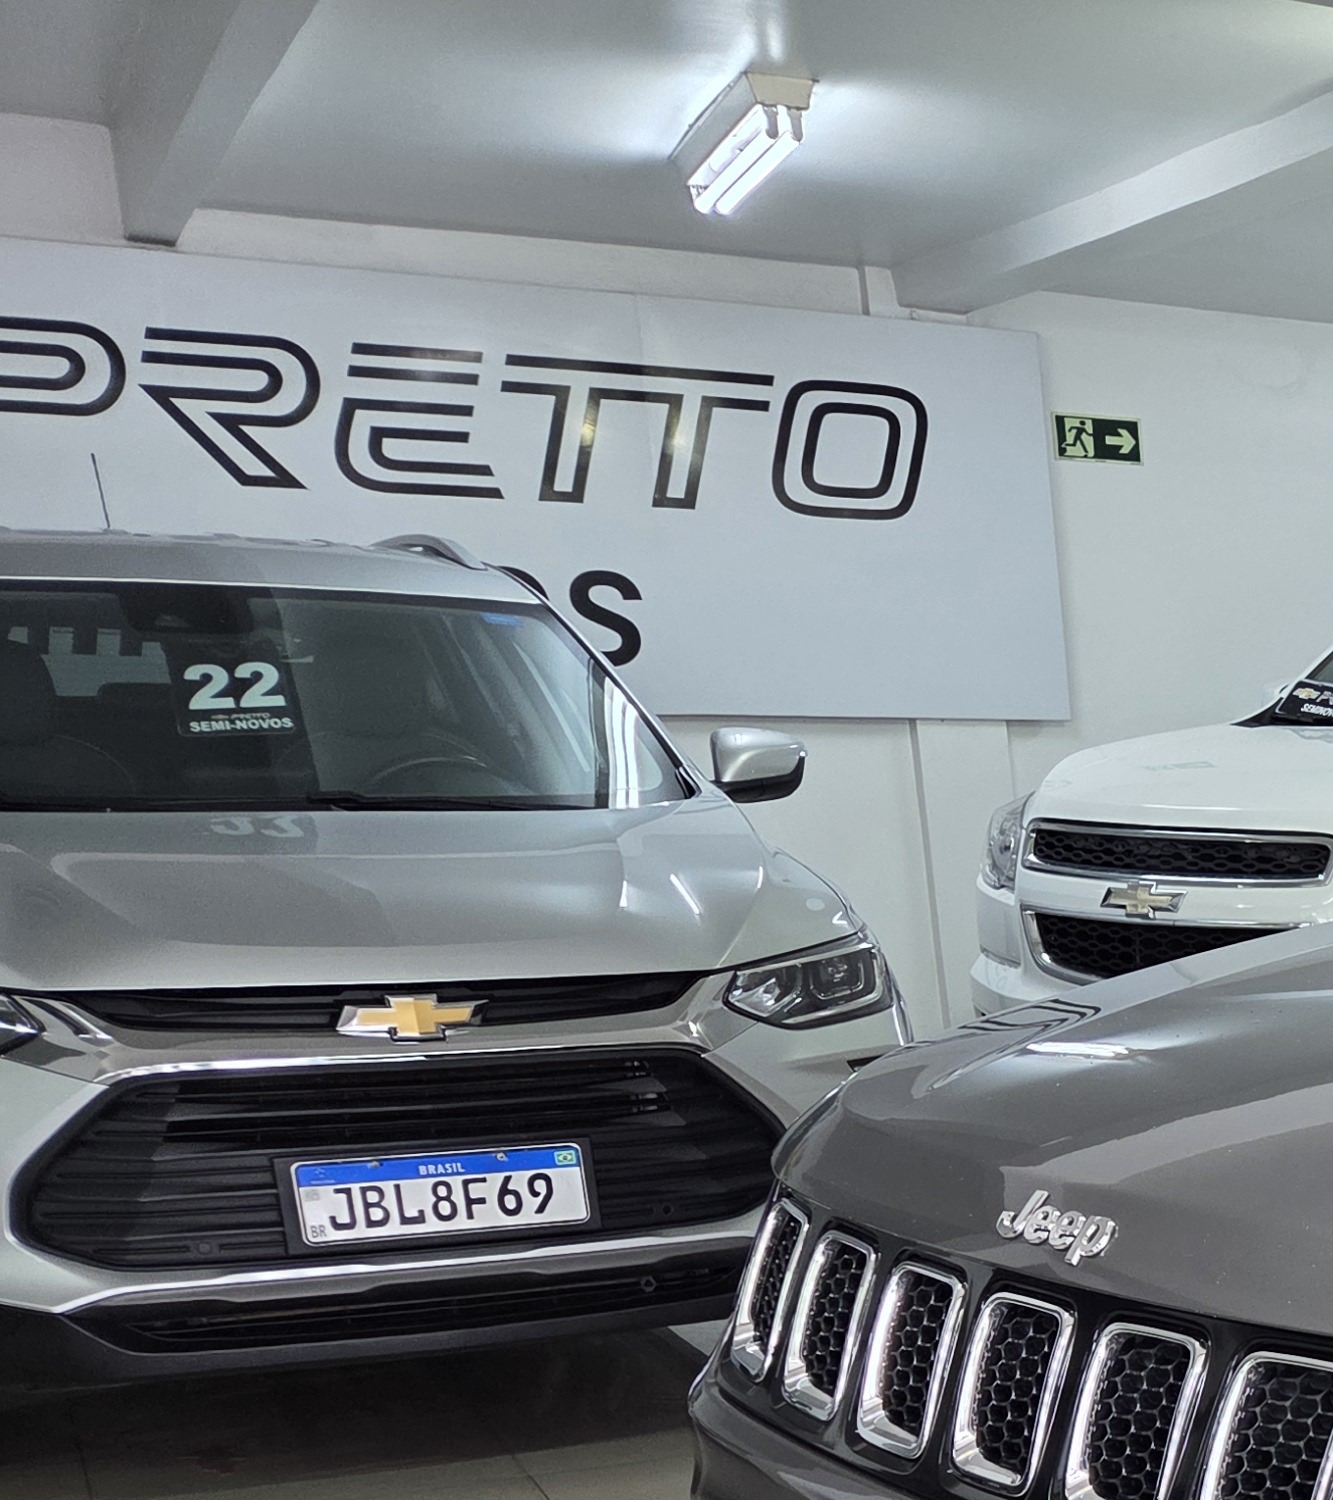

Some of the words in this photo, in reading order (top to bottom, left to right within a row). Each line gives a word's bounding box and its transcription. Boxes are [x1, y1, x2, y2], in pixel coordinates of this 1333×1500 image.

[183, 662, 286, 710] 22
[189, 717, 295, 732] SEMI-NOVOS
[418, 1162, 466, 1175] BRASIL
[328, 1172, 555, 1232] JBL8F69
[310, 1224, 327, 1239] BR
[996, 1189, 1118, 1267] Jeep
